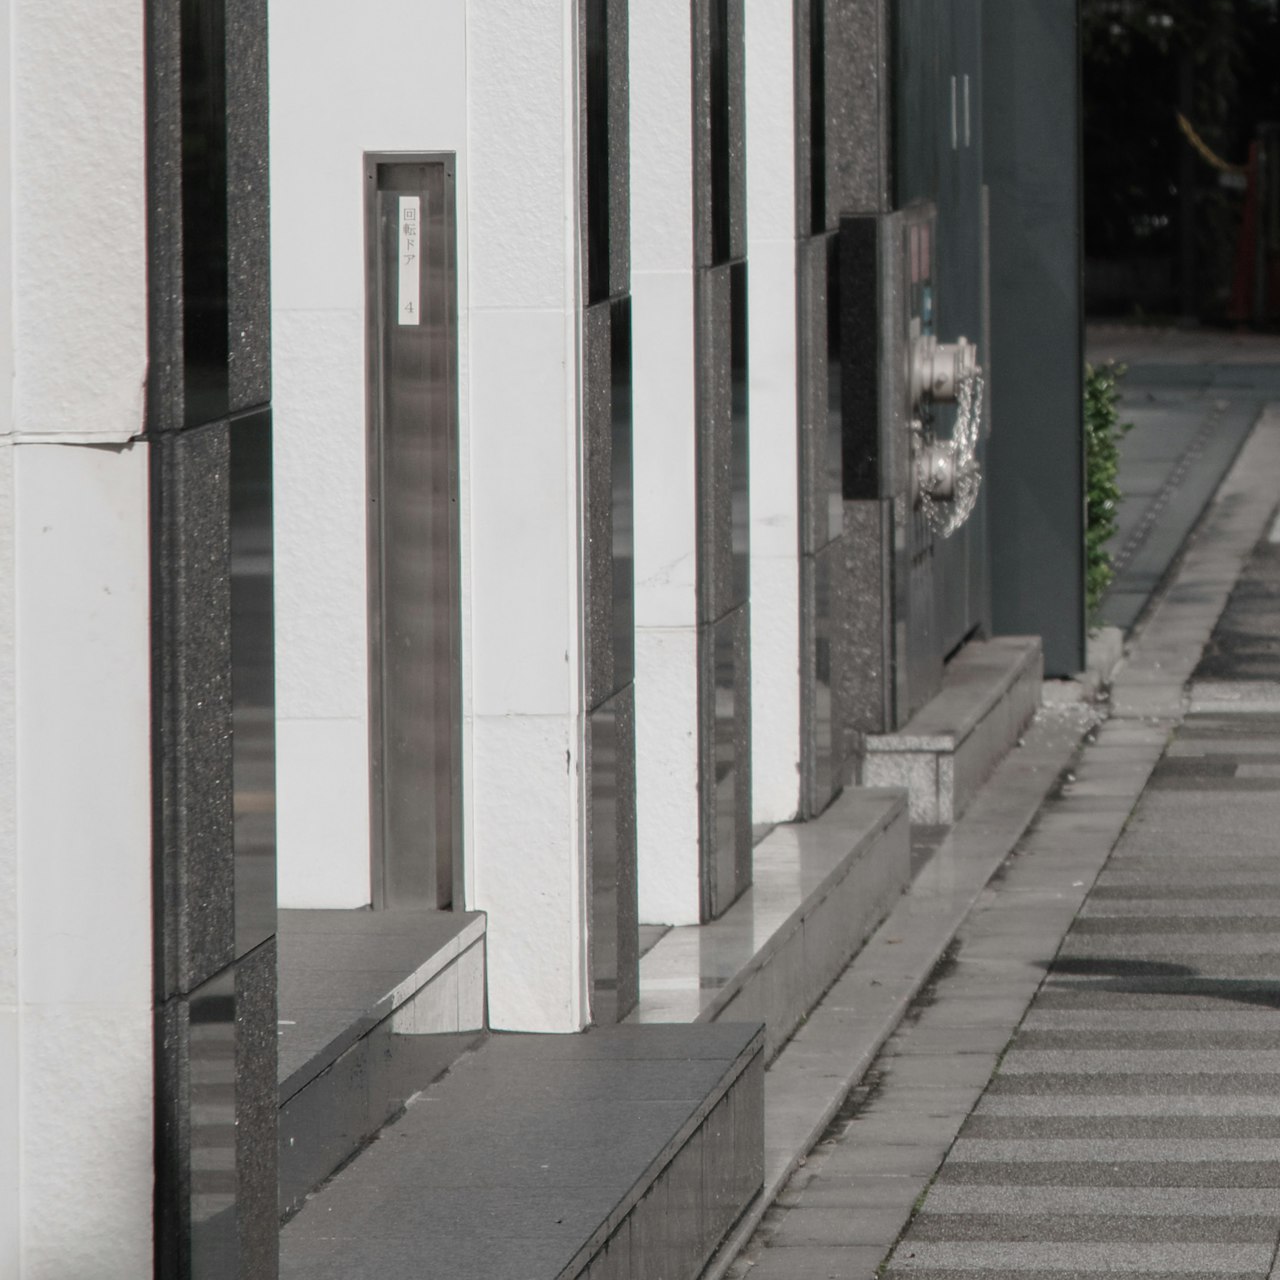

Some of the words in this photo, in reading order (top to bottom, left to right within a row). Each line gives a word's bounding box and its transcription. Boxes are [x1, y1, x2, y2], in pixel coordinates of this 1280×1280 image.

[403, 208, 417, 265] 回転ドア
[404, 301, 415, 313] 4
